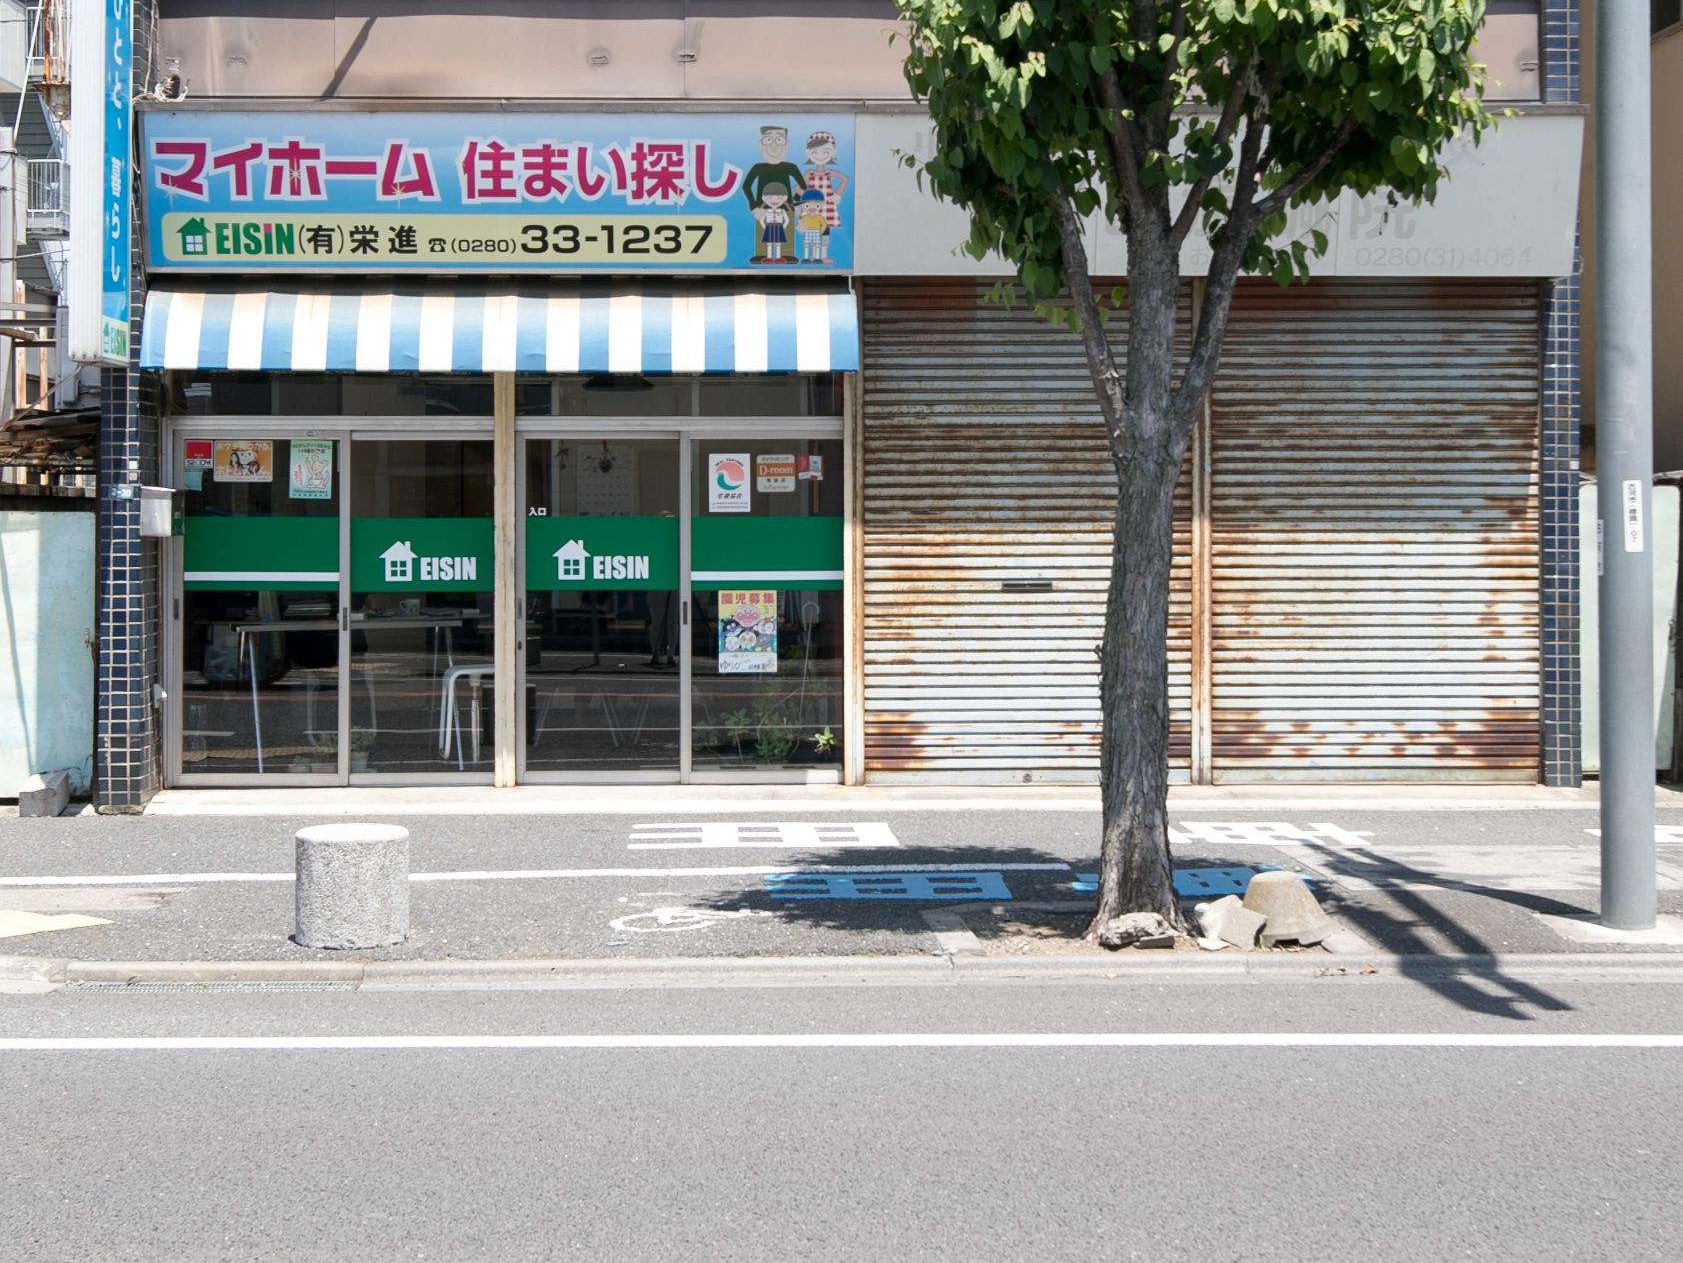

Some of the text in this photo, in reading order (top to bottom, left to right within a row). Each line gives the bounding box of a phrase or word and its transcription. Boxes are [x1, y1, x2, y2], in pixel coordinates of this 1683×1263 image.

[153, 138, 740, 201] マイホーム 住まい探し
[215, 223, 295, 255] EISIN
[451, 238, 517, 254] (0280)
[520, 224, 713, 254] 33-1237
[759, 465, 793, 476] D-room
[528, 506, 547, 517] 入口
[420, 556, 477, 581] EISIN
[593, 555, 649, 580] EISIN
[721, 592, 775, 605] 園児募集
